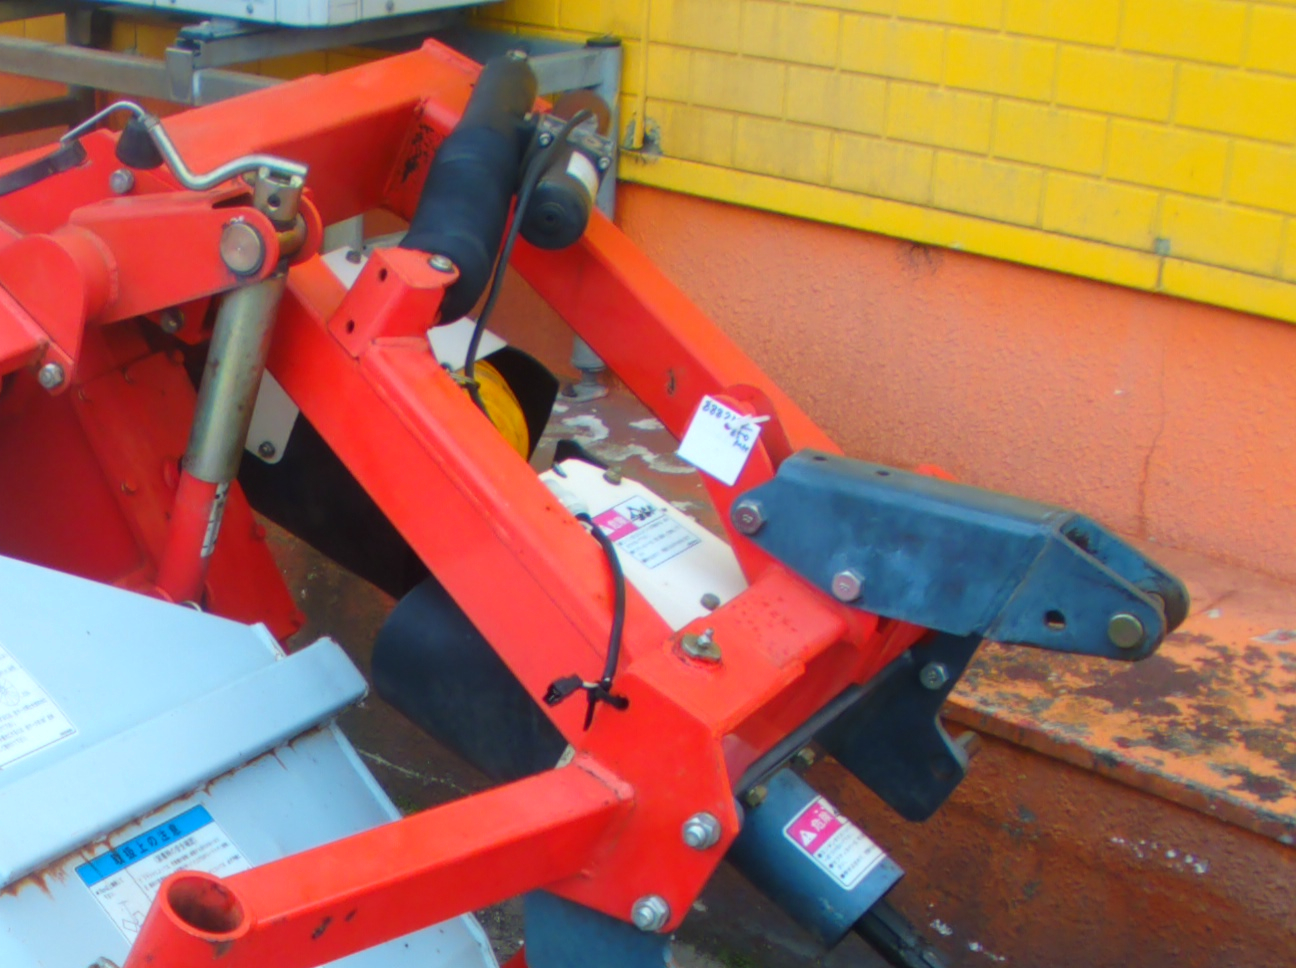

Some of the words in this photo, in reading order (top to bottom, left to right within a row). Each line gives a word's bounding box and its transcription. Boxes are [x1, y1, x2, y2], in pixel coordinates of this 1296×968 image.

[110, 823, 182, 866] 取扱上の注意
